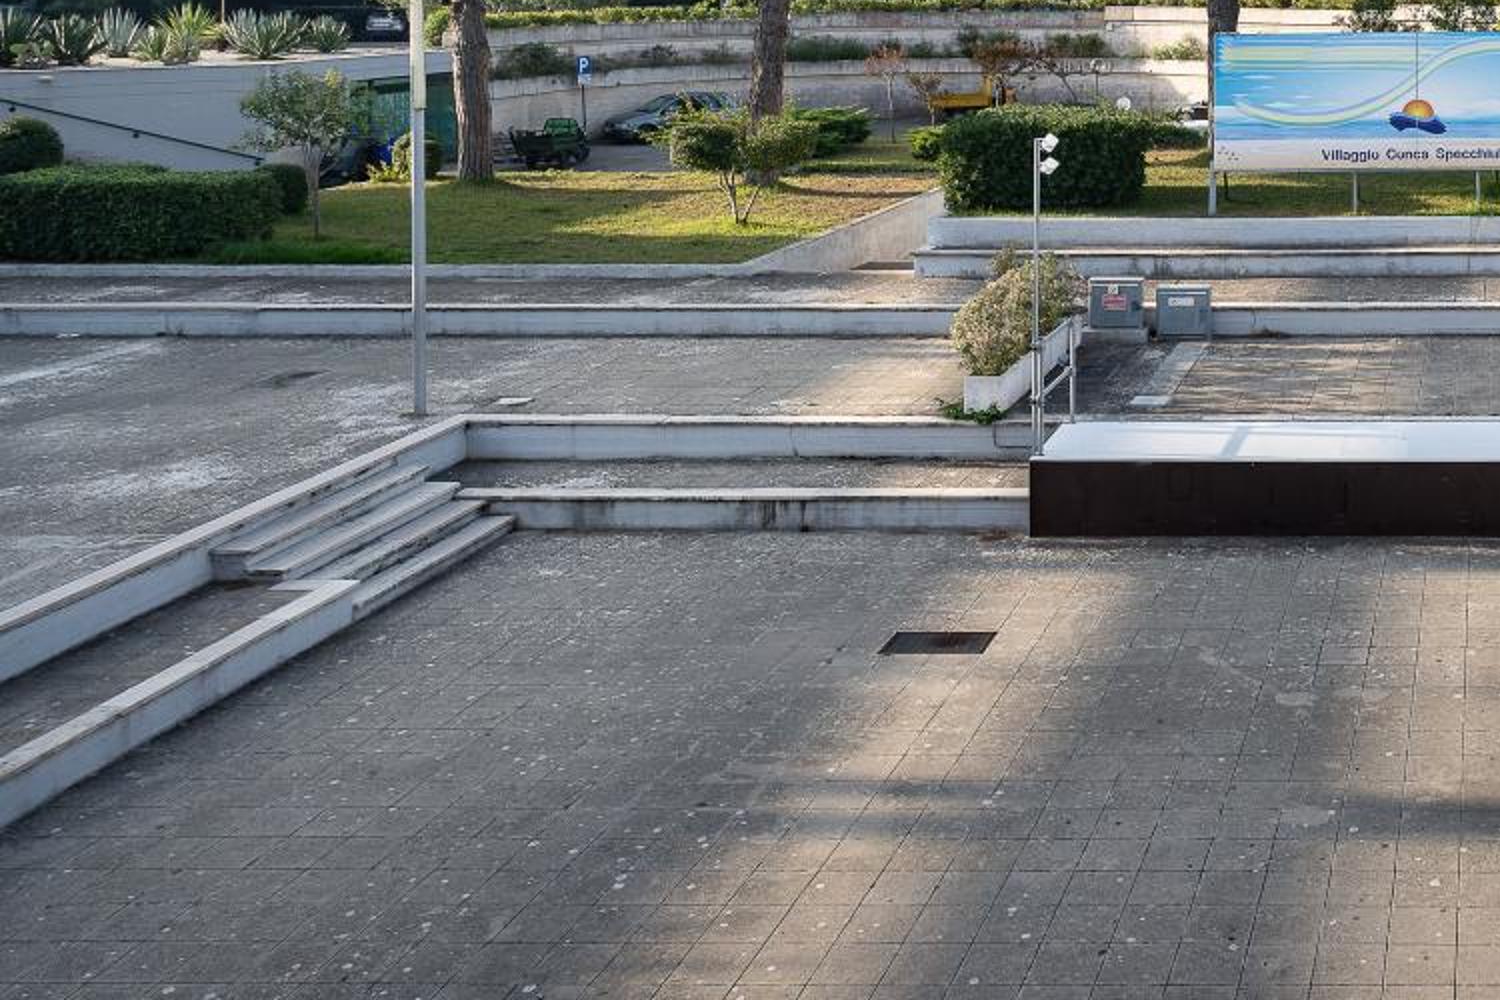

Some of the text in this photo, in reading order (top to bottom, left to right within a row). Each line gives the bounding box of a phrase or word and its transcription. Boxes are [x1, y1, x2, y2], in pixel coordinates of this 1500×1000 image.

[579, 57, 589, 73] P
[1321, 148, 1380, 163] Villaggio
[1385, 147, 1429, 160] Conca
